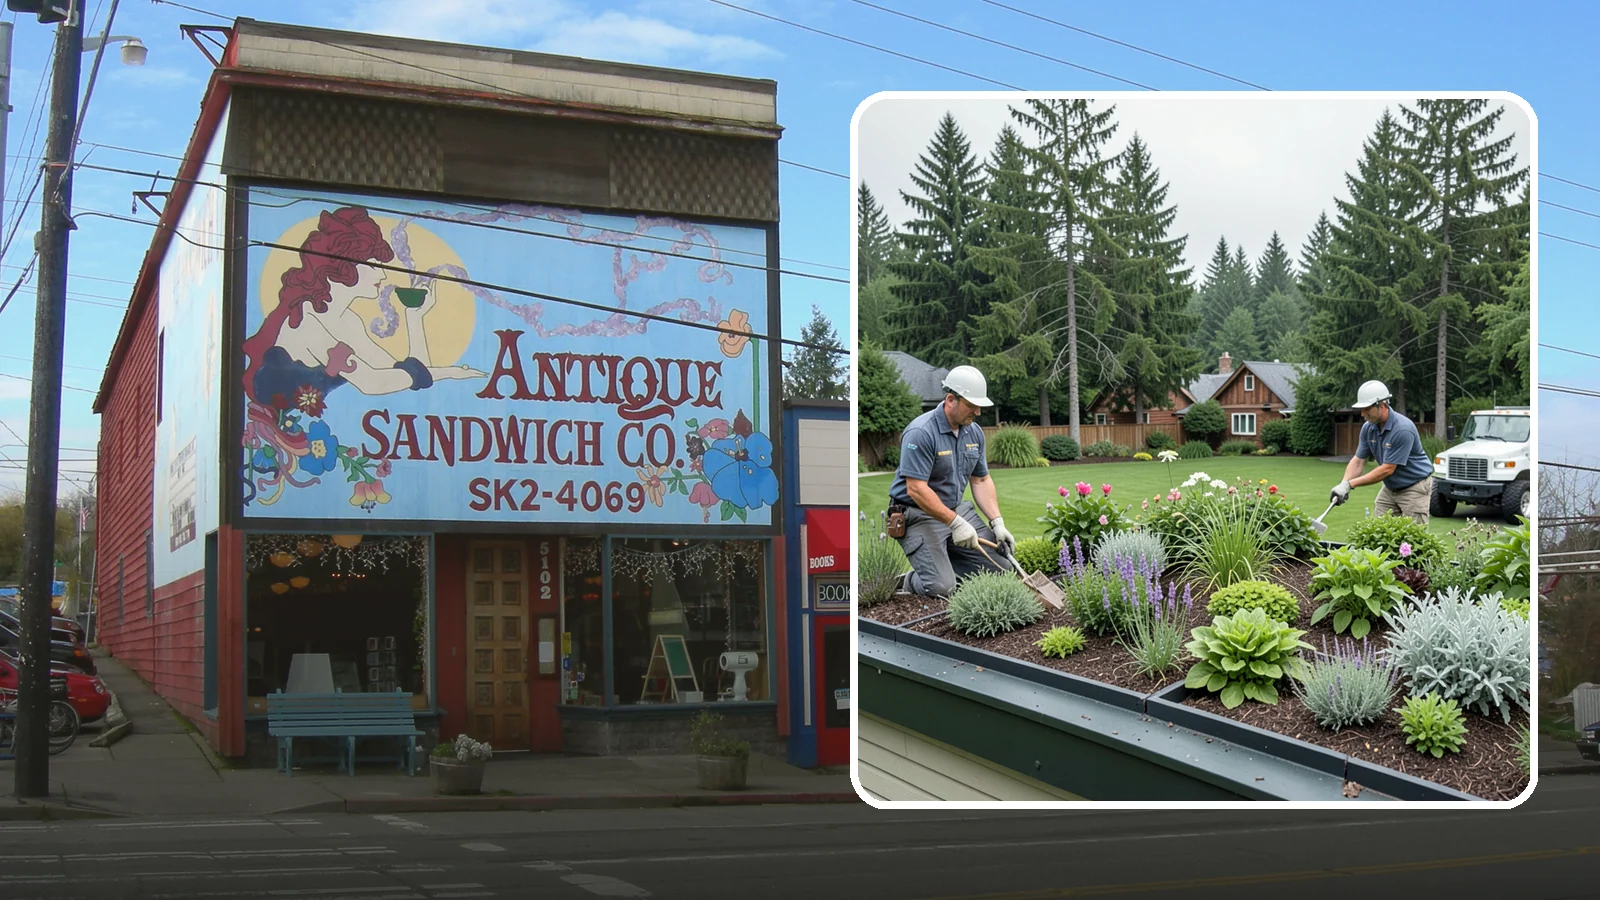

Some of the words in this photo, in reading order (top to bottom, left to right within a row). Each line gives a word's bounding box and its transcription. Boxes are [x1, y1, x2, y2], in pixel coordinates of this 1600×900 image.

[476, 328, 723, 420] ANTIQUE
[361, 408, 604, 467] SANDWICH
[617, 421, 685, 469] CO.
[468, 477, 646, 512] SK2-4069
[540, 541, 551, 600] 5102
[809, 555, 835, 569] BOOKS
